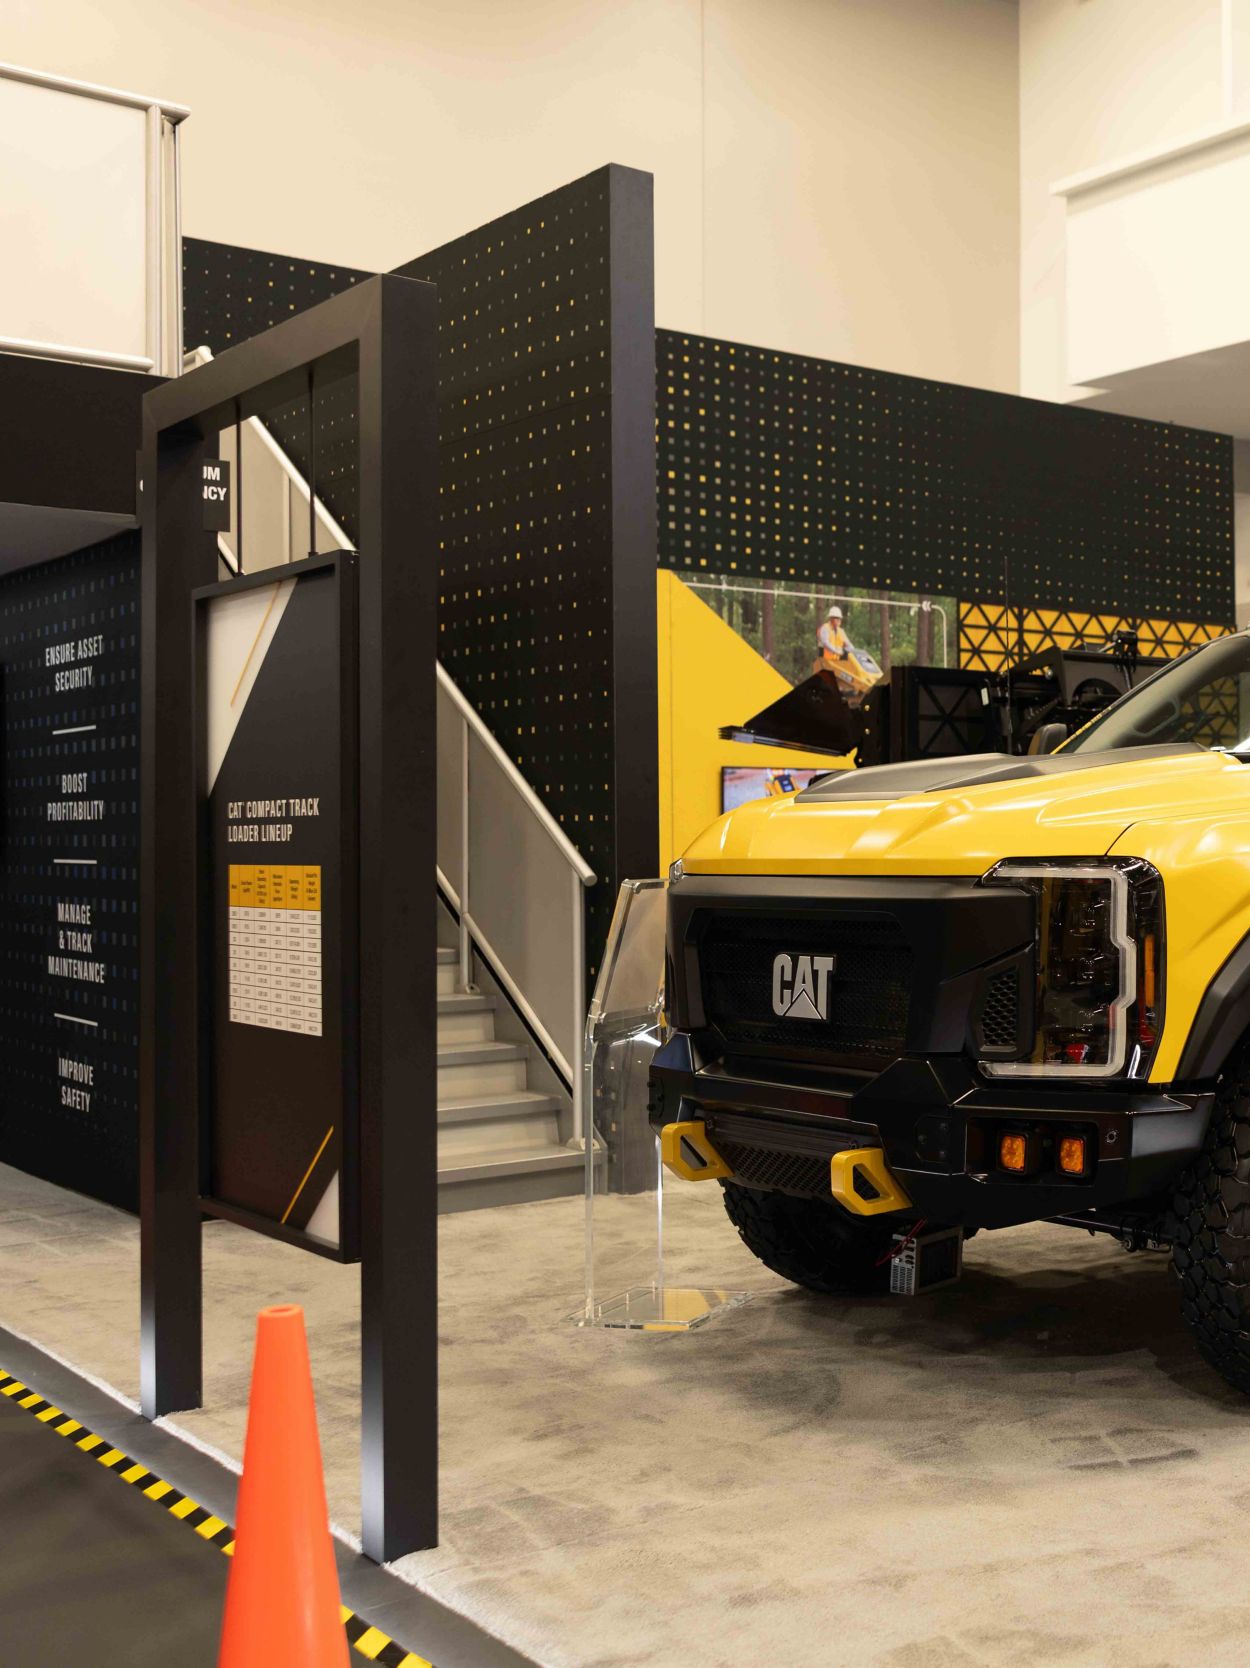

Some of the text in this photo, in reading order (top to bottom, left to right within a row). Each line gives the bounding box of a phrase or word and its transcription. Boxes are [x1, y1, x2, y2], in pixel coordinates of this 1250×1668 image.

[45, 635, 104, 667] ENSURE ASSET
[55, 666, 93, 692] SECURITY
[61, 773, 88, 793] BOOST
[47, 800, 104, 821] PROFITABILITY
[246, 800, 286, 818] COMPACT
[288, 798, 320, 816] TRACK
[228, 824, 293, 842] LOADER LINEUP
[57, 902, 91, 925] MANAGE
[58, 929, 93, 954] & TRACK
[48, 955, 105, 984] MAINTENANCE
[772, 953, 834, 1020] CAT
[58, 1057, 94, 1086] IMPROVE
[61, 1086, 91, 1113] SAFETY
